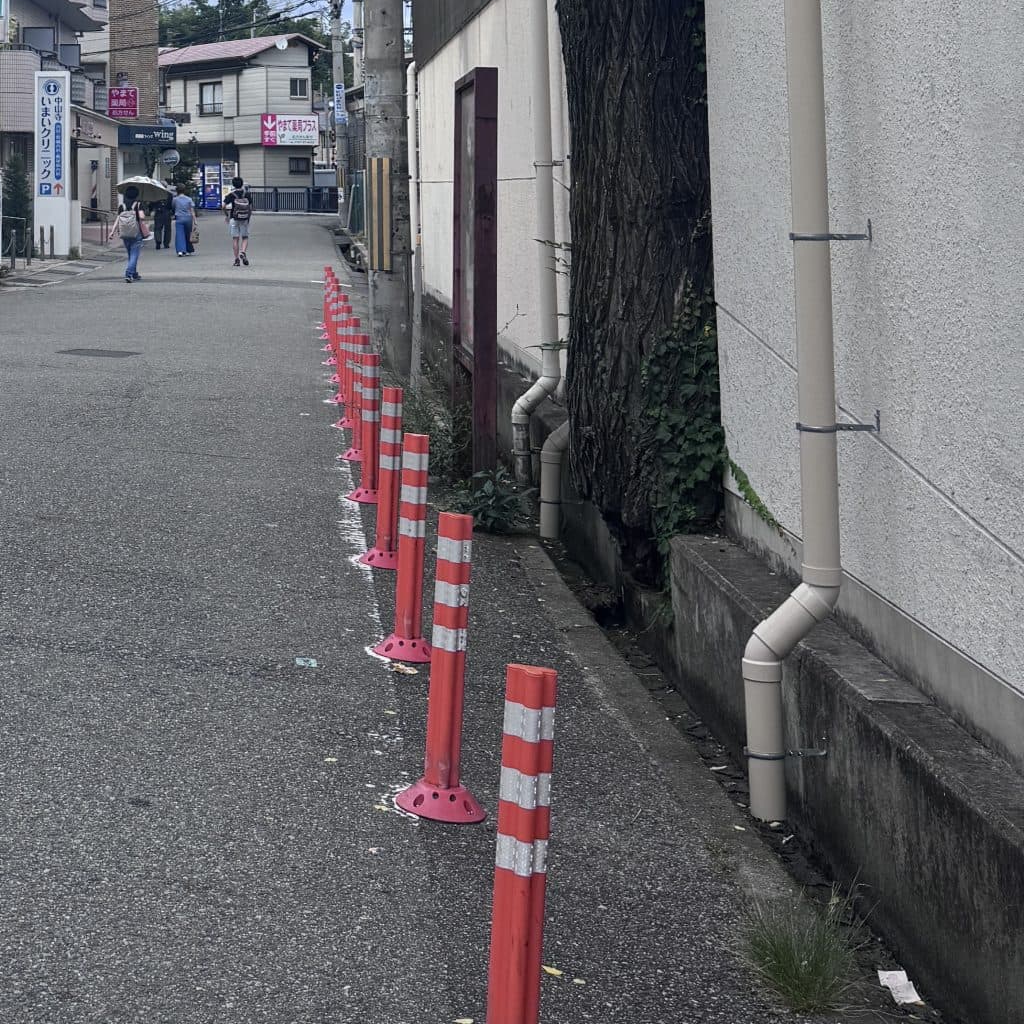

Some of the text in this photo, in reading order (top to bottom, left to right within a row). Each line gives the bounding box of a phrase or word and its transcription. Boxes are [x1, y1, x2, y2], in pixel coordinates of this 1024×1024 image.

[41, 96, 51, 180] いまいクリニック
